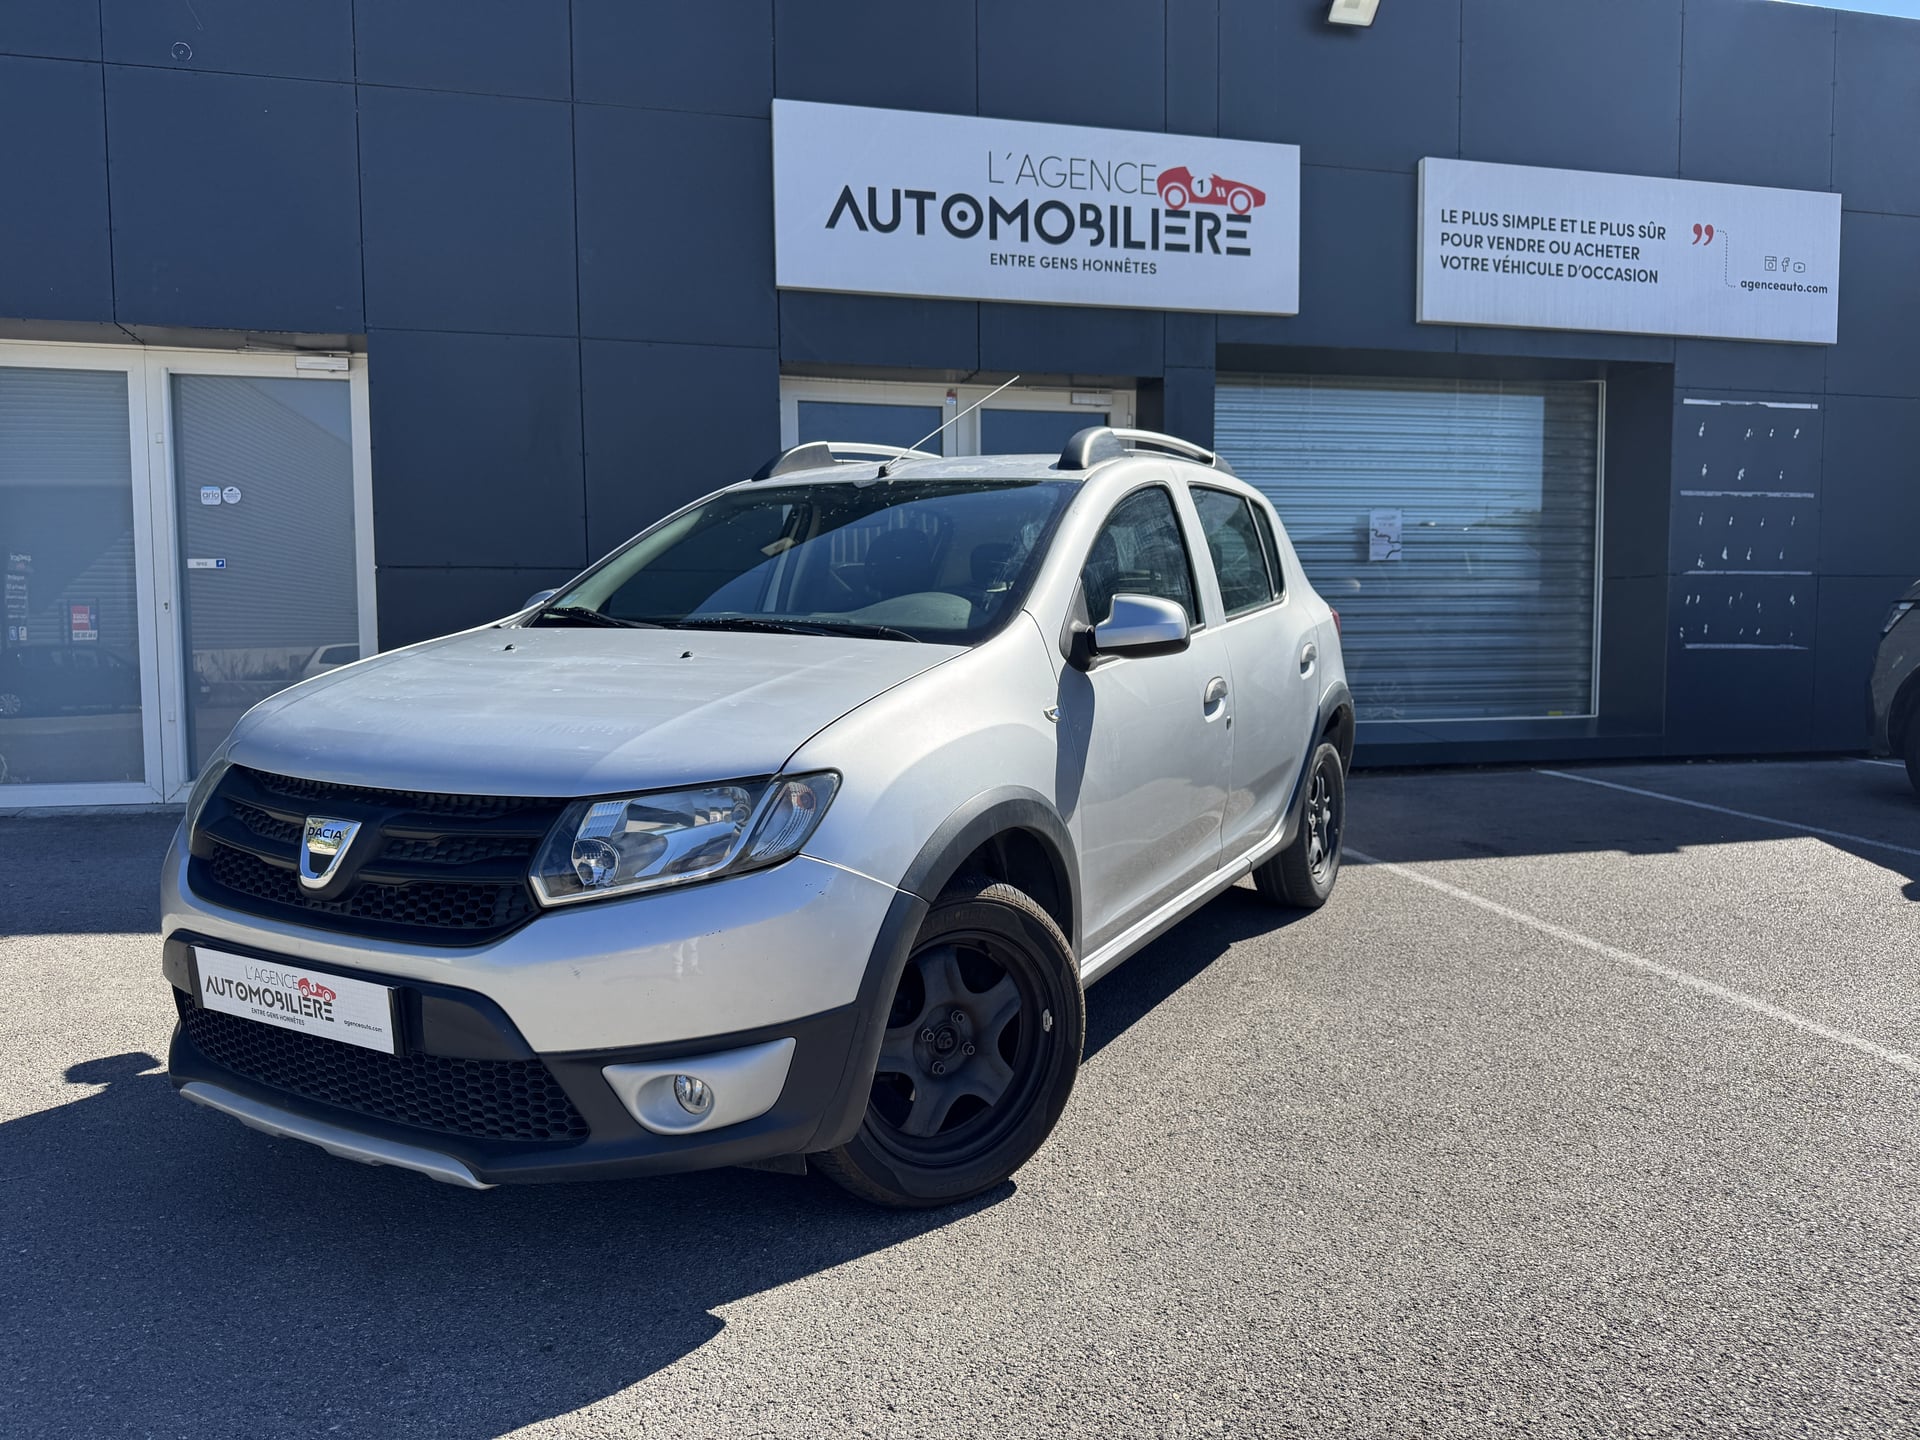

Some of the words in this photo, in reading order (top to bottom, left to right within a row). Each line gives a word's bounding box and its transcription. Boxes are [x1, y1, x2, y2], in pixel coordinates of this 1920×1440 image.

[989, 151, 1158, 197] L'AGENCE
[1441, 209, 1458, 224] LE
[1462, 210, 1499, 227] PLUS
[1502, 214, 1557, 231] SIMPLE
[1560, 218, 1577, 233] ET
[1580, 220, 1596, 234] LE
[1600, 222, 1635, 237] PLUS
[1638, 221, 1666, 240] SÛR
[1441, 232, 1483, 249] POUR
[1487, 235, 1545, 253] VENDRE
[1549, 240, 1571, 255] OU
[1573, 242, 1640, 260] ACHETER
[990, 253, 1035, 267] ENTRE
[1040, 256, 1078, 270] GENS
[1082, 257, 1157, 275] HONNÊTES
[1440, 254, 1489, 272] VOTRE
[1492, 254, 1564, 277] VÉHICULE
[1567, 264, 1659, 284] D'OCCASION
[1740, 280, 1828, 294] agenceauto.com
[307, 826, 342, 840] DACIA
[251, 1007, 266, 1017] ENTRE
[266, 1010, 279, 1020] GENS
